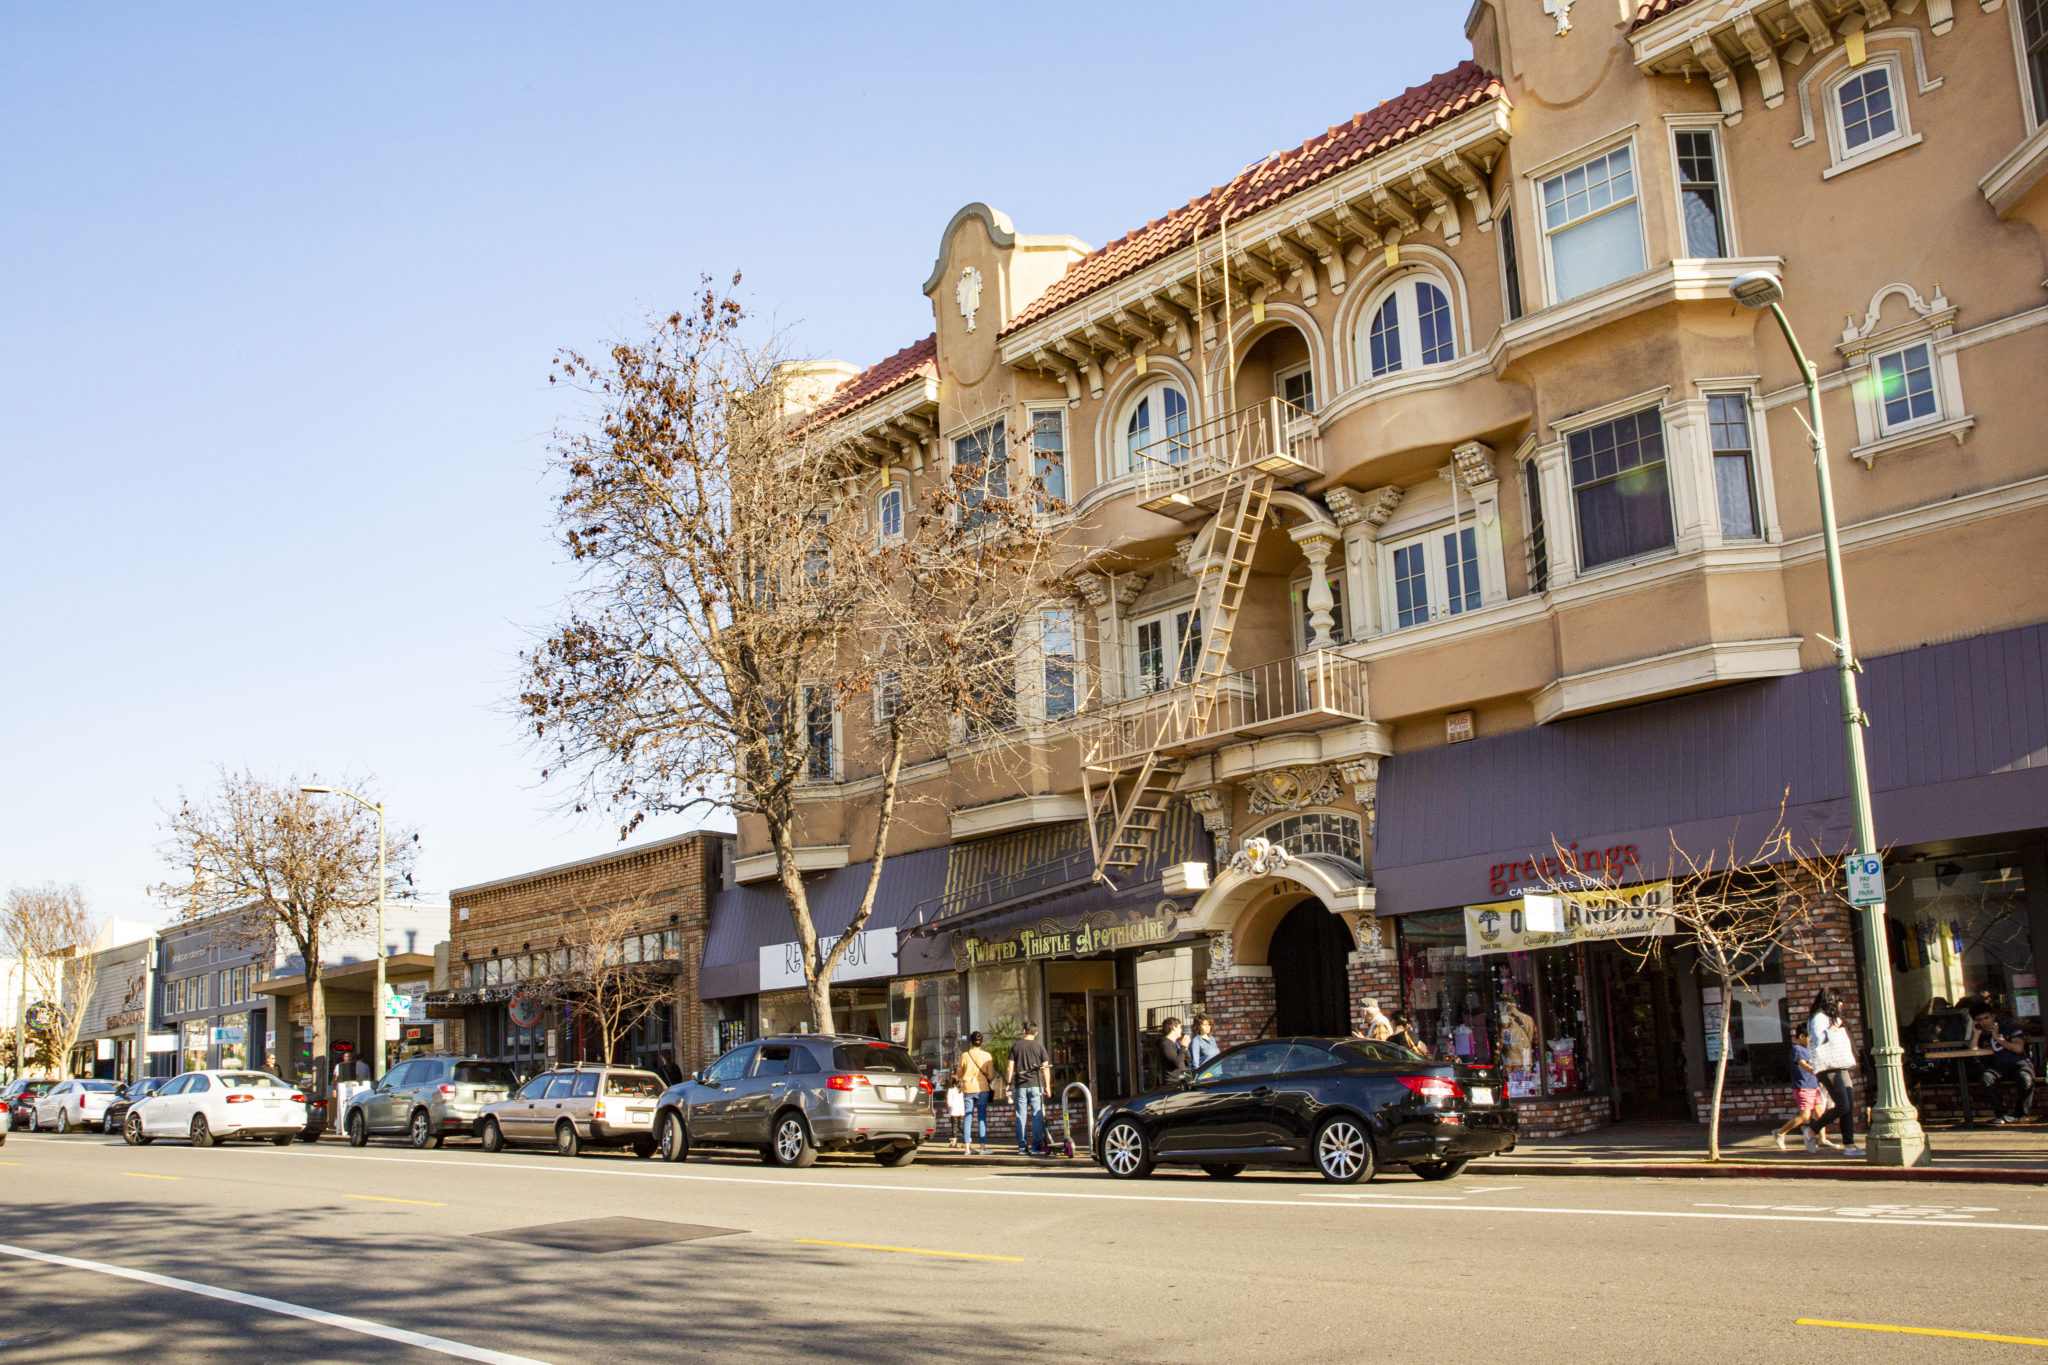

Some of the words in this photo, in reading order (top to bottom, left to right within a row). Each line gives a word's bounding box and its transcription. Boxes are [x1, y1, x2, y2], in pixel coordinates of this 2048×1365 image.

[1489, 843, 1639, 895] greetings
[1273, 880, 1311, 896] 415
[1510, 890, 1662, 934] OANDISH
[965, 938, 1017, 967] TWISTED
[1021, 930, 1071, 959] THISTLE
[1523, 933, 1551, 947] Quality
